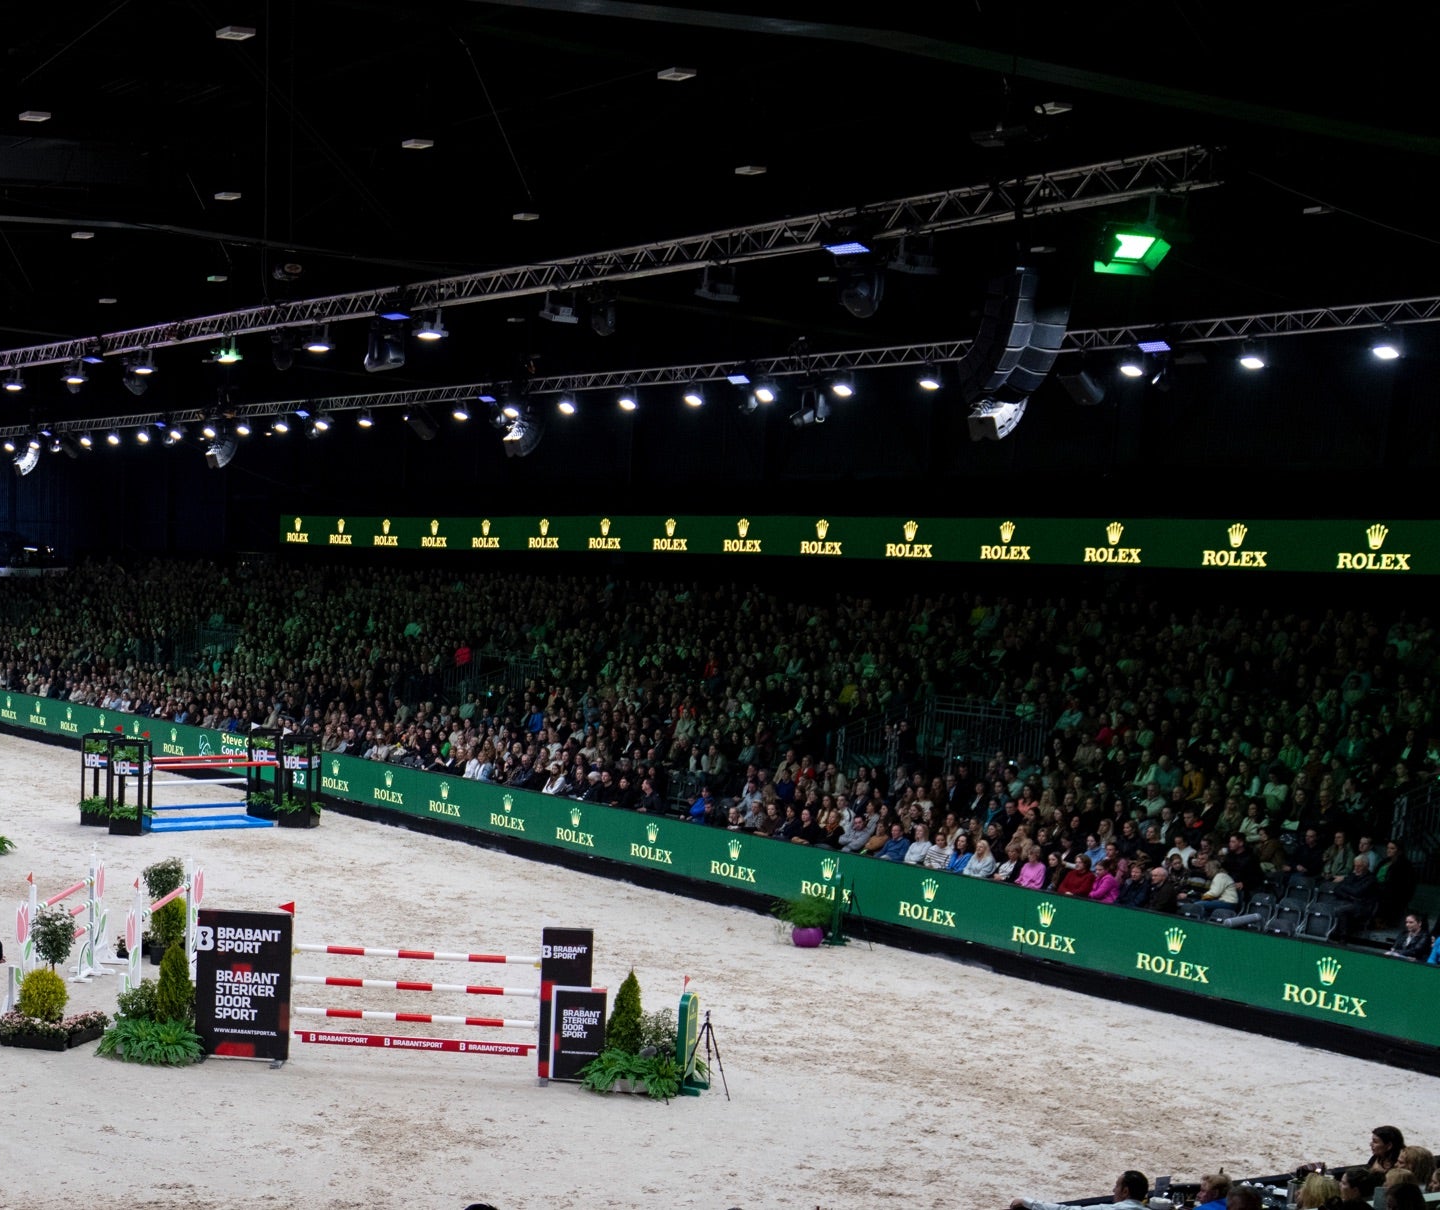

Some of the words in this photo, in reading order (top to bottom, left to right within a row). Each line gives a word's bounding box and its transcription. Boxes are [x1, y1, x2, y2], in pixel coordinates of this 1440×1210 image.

[287, 532, 308, 543] ROLEX
[330, 534, 352, 545] ROLEX
[374, 536, 398, 546] ROLEX
[421, 536, 447, 548] ROLEX
[472, 537, 500, 549] ROLEX
[528, 537, 559, 549] ROLEX
[588, 537, 621, 550] ROLEX
[653, 538, 688, 551] ROLEX
[724, 539, 762, 552] ROLEX
[800, 541, 842, 555] ROLEX
[886, 544, 932, 558] ROLEX
[980, 546, 1030, 560] ROLEX
[1084, 548, 1141, 564] ROLEX
[1202, 550, 1267, 567] ROLEX
[1336, 552, 1411, 570] ROLEX
[1, 708, 17, 720] ROLEX
[30, 714, 46, 726] ROLEX
[60, 720, 78, 733] ROLEX
[222, 733, 242, 747] Steve
[163, 743, 184, 756] ROLEX
[322, 776, 349, 792] ROLEX
[374, 788, 403, 804] ROLEX
[429, 800, 460, 817] ROLEX
[490, 812, 525, 832] ROLEX
[556, 827, 594, 848] ROLEX
[630, 843, 673, 864] ROLEX
[711, 860, 756, 883] ROLEX
[800, 880, 852, 904] ROLX
[898, 901, 956, 928] ROLEX
[217, 927, 281, 942] BRABANT
[1012, 926, 1076, 954] ROLEX
[217, 940, 261, 954] SPORT
[553, 946, 588, 954] BRABANT
[1136, 952, 1209, 984] ROLEX
[216, 970, 280, 985] BRABANT
[216, 982, 274, 997] STERKER
[216, 995, 251, 1008] DOOR
[1282, 983, 1367, 1018] ROLEX
[215, 1008, 258, 1021] SPORT
[563, 1009, 601, 1018] BRABANT
[562, 1017, 598, 1025] STERKER
[318, 1034, 368, 1044] BRABANTSPORT
[393, 1039, 443, 1049] BRABANTSPORT
[468, 1044, 519, 1053] BRABANTSPORT
